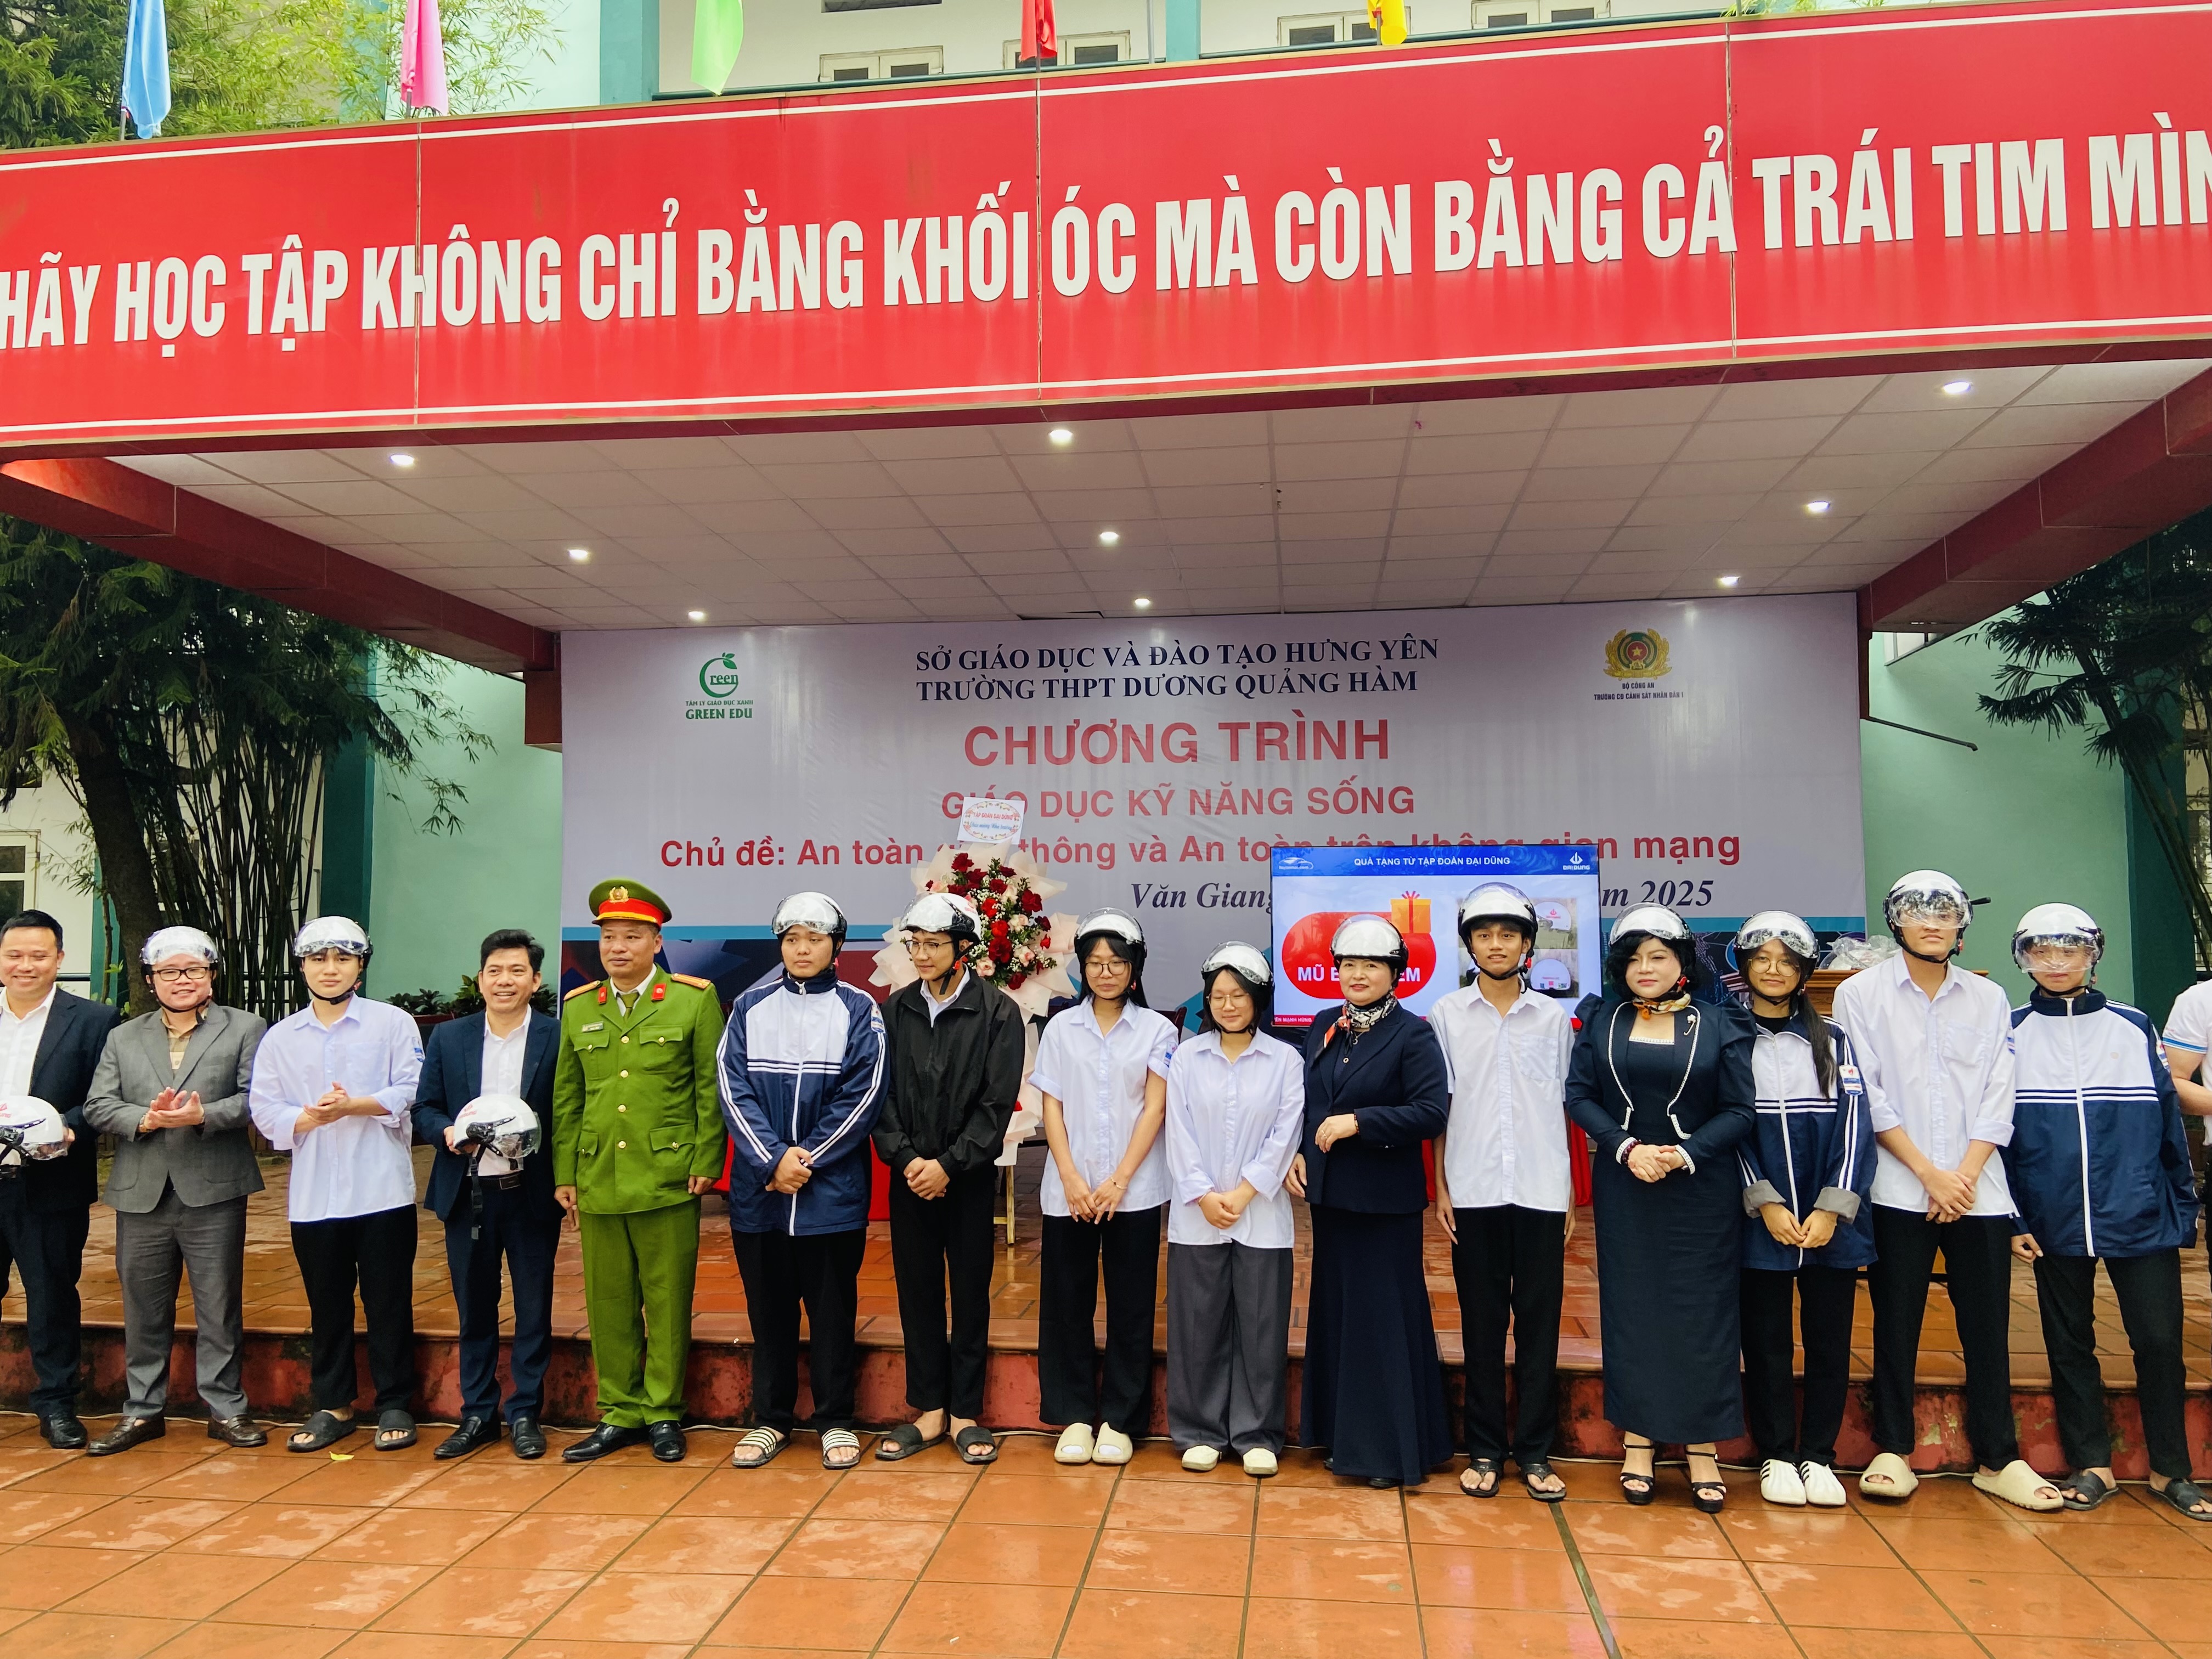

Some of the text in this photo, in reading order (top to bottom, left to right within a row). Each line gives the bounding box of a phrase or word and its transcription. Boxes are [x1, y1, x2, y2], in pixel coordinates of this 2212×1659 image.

[0, 251, 101, 349] HÃY
[114, 255, 227, 358] HỌC
[241, 234, 348, 352] TẬP
[362, 224, 561, 329] KHÔNG
[579, 198, 679, 320] CHỈ
[697, 189, 864, 314] BẰNG
[884, 181, 1029, 306] KHỐI
[1051, 185, 1136, 296] ÓC
[1156, 175, 1259, 290] MÀ
[1275, 166, 1412, 283] CÒN
[1434, 138, 1623, 272] BẰNG
[1642, 125, 1738, 258] CẢ
[1752, 127, 1914, 249] TRÁI
[1932, 138, 2068, 237] TIM
[916, 632, 1438, 673] SỞ GIÁO DỤC VÀ ĐÀO TẠO HƯNG YÊN
[916, 665, 1418, 701] TRƯỜNG THPT DƯƠNG QUẢNG HÀM
[686, 708, 752, 719] GREEN EDU
[964, 709, 1388, 766] CHƯƠNG TRÌNH
[1041, 790, 1113, 822] DỤC
[1128, 783, 1176, 816] KỸ
[1190, 782, 1293, 815] NĂNG
[1308, 775, 1414, 815] SỐNG
[661, 836, 724, 867] Chủ
[736, 835, 785, 866] đề:
[797, 839, 840, 865] An
[853, 838, 923, 865] toàn
[1130, 834, 1167, 862] và
[1180, 836, 1224, 862] An
[1634, 836, 1740, 866] mạng
[1354, 857, 1374, 866] QUÀ
[1376, 858, 1400, 867] TẠNG
[1418, 856, 1436, 867] TẬP
[1437, 856, 1464, 865] ĐOÀN
[1466, 857, 1481, 867] ĐẠI
[1483, 855, 1510, 865] DŨNG
[1131, 883, 1187, 909] Văn
[1640, 880, 1714, 906] 2025
[1297, 963, 1324, 981] MŨ
